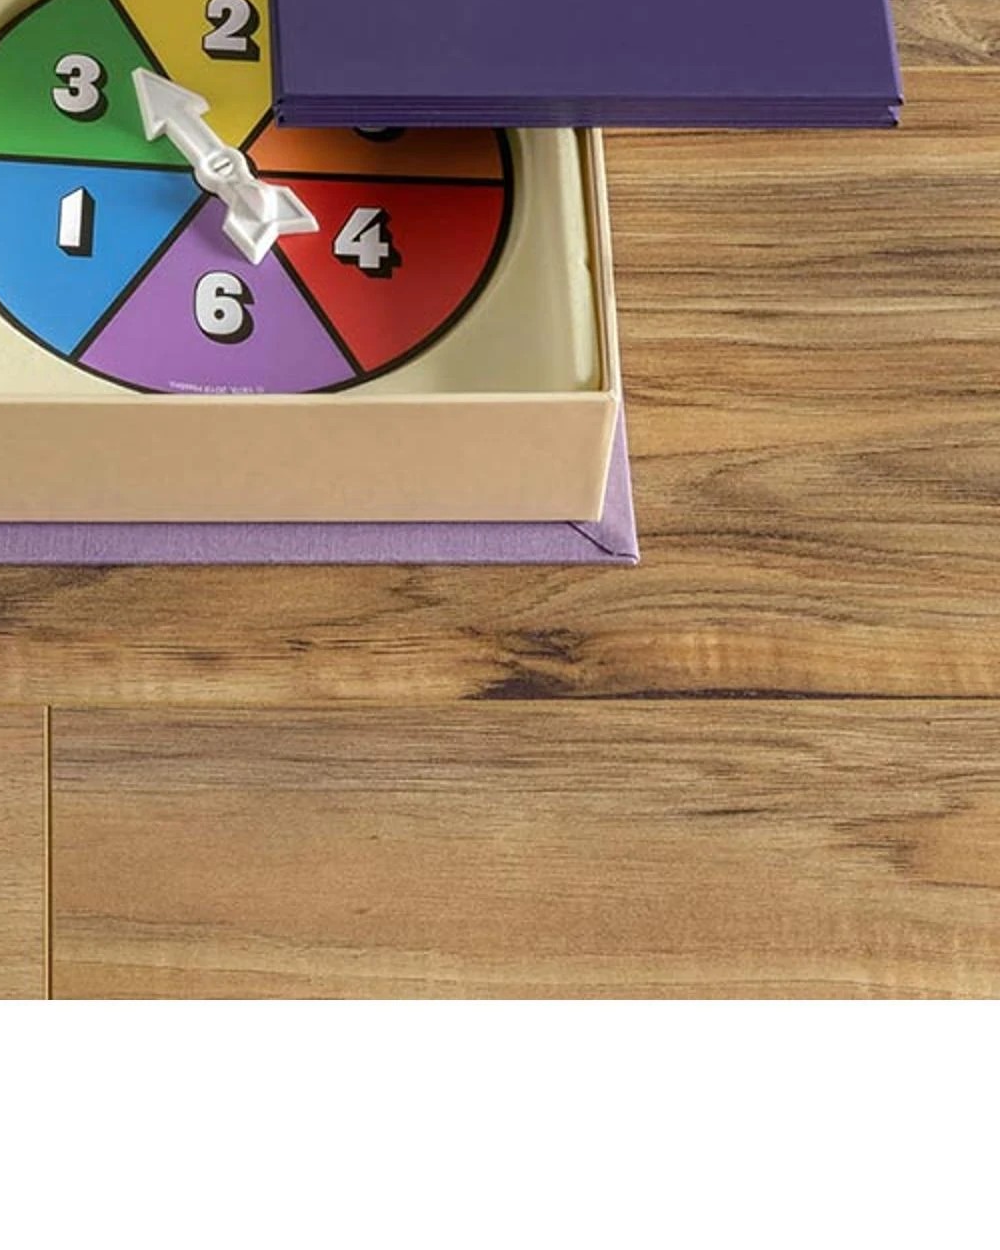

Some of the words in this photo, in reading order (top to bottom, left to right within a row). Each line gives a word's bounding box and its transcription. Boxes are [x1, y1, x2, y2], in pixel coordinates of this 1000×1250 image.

[52, 54, 104, 117] 3
[58, 185, 91, 252] 1
[334, 207, 395, 273] 4
[194, 271, 249, 338] 6
